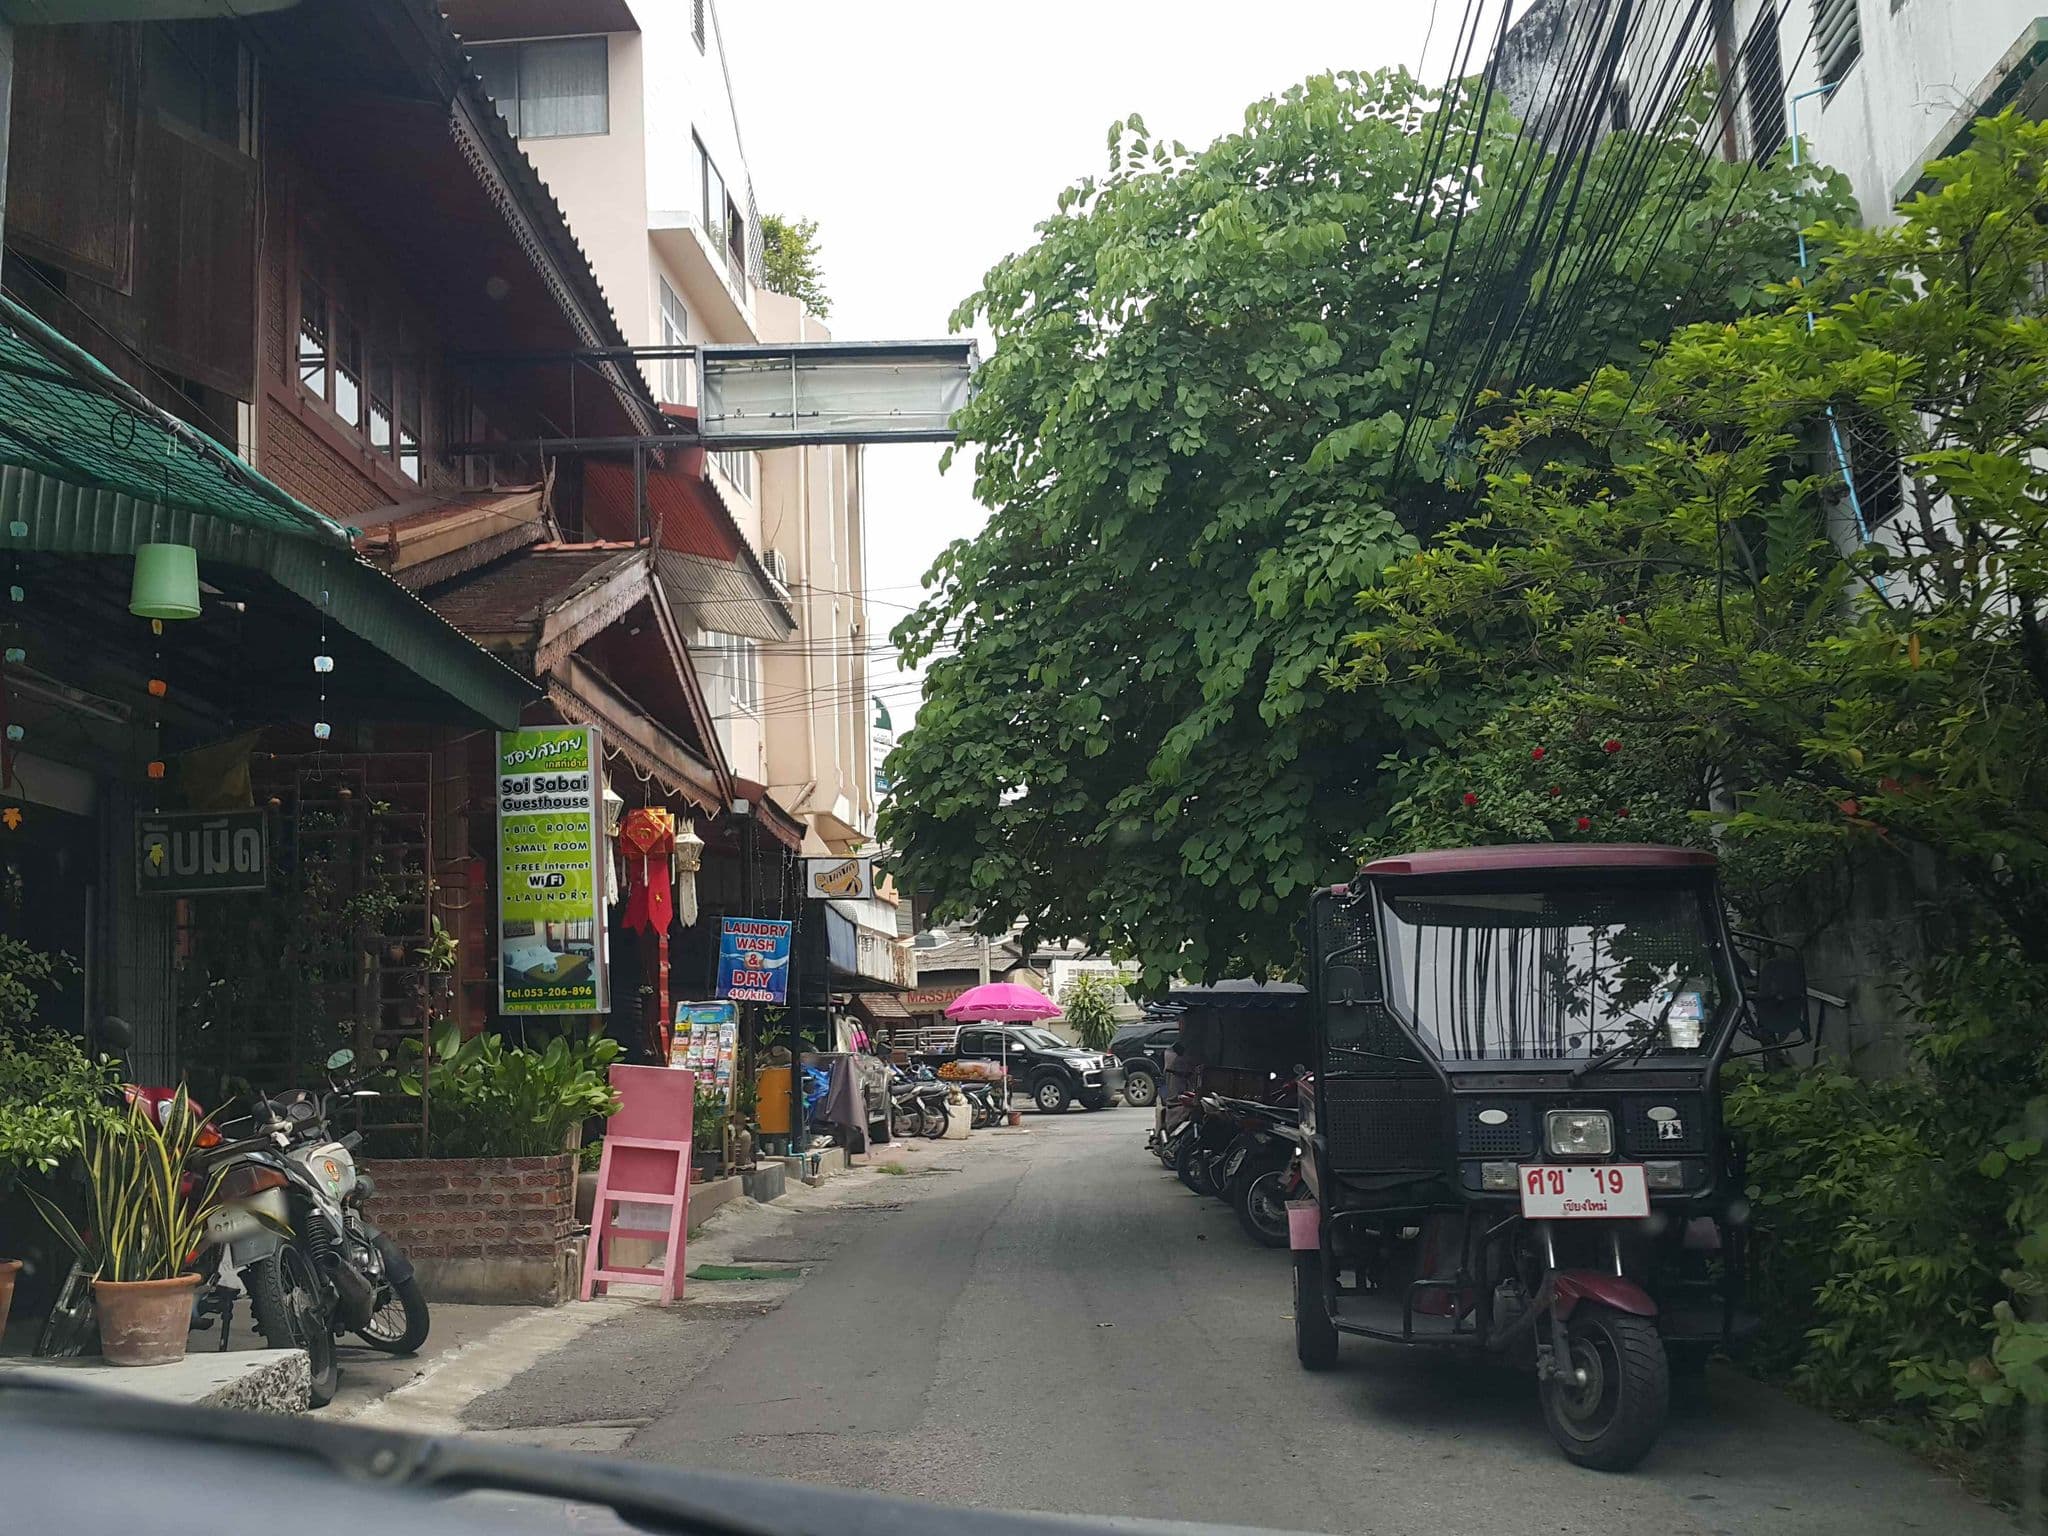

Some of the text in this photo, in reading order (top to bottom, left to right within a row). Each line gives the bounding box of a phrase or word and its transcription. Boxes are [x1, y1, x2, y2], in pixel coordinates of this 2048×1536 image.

[502, 775, 588, 795] Soi Sabai
[502, 796, 589, 811] Guesthouse
[513, 822, 587, 834] BIG ROOM
[514, 842, 587, 853] SMALL ROOM
[515, 862, 589, 872] FREE Internet
[515, 891, 587, 902] LAUNDRY
[724, 921, 788, 938] LAUNDRY
[736, 937, 776, 952] WASH
[748, 953, 758, 966] &
[732, 969, 773, 988] DRY
[728, 988, 774, 1002] 40/kilo
[907, 987, 967, 1004] MASSAG
[507, 1004, 532, 1012] OPEN
[536, 1003, 561, 1011] DAILY
[1527, 1168, 1624, 1195] ศข 19
[1563, 1199, 1608, 1212] เชียงใหม่
